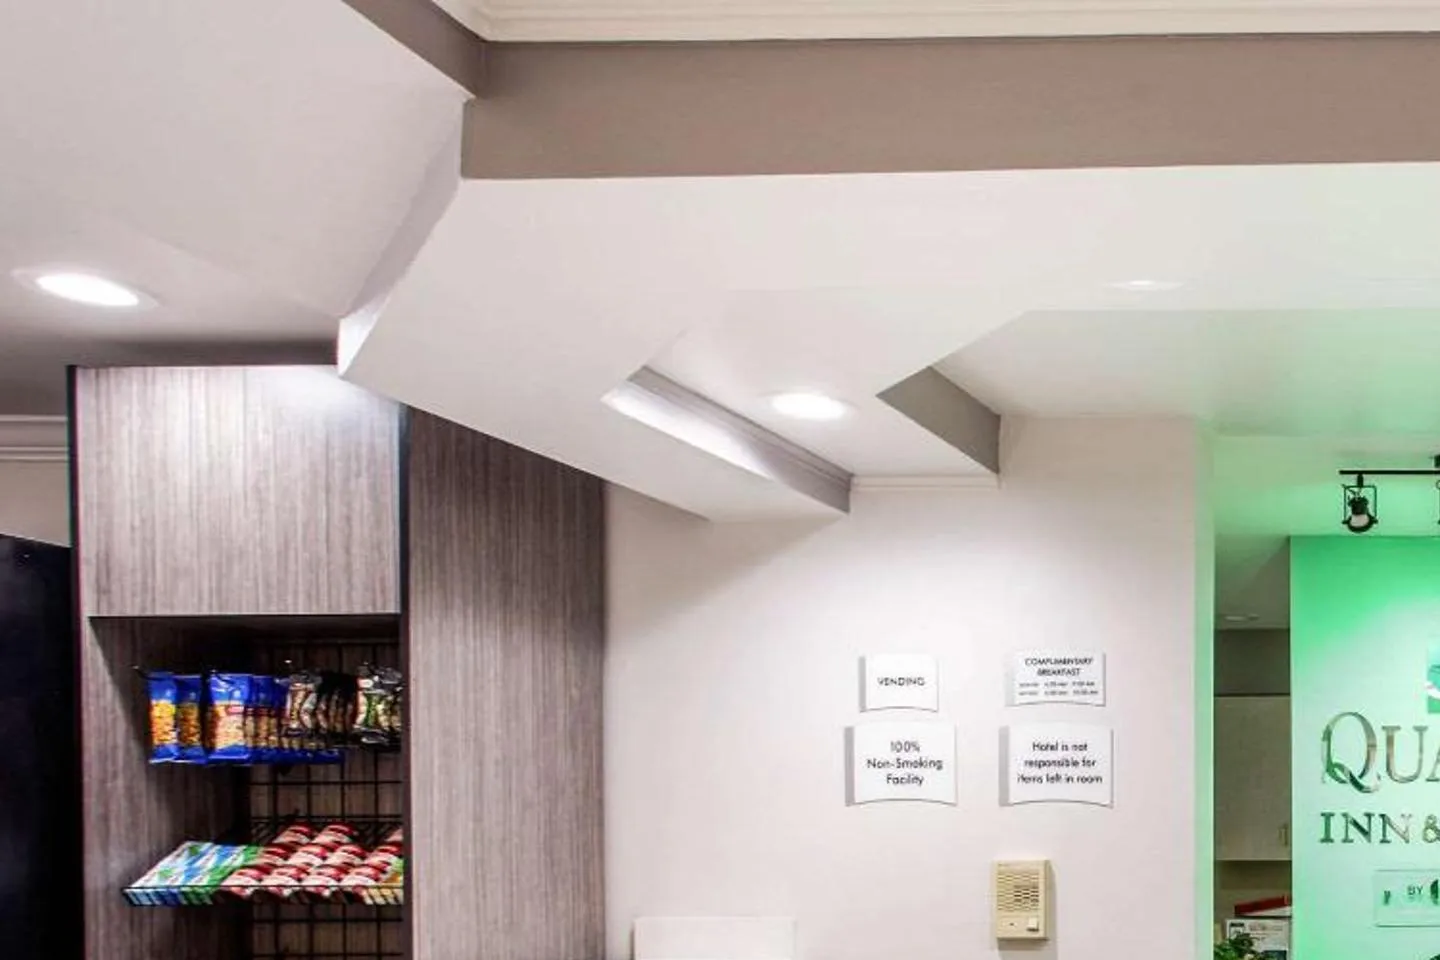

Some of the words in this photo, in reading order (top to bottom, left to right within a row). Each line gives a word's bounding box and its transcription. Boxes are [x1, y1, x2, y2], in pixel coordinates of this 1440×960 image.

[1037, 667, 1081, 676] BREAKFAST
[877, 676, 926, 687] VENDING
[890, 740, 920, 753] 100%
[1032, 740, 1059, 752] Hotel
[1061, 740, 1069, 752] is
[1071, 741, 1088, 752] not
[866, 757, 943, 771] Non-Smoking
[1024, 757, 1080, 769] responsible
[1081, 756, 1096, 767] for
[886, 773, 924, 787] Facility
[1016, 773, 1043, 784] items
[1046, 773, 1062, 784] left
[1064, 773, 1074, 784] in
[1076, 775, 1103, 784] room
[1319, 811, 1413, 844] INN
[1407, 885, 1424, 896] BY
